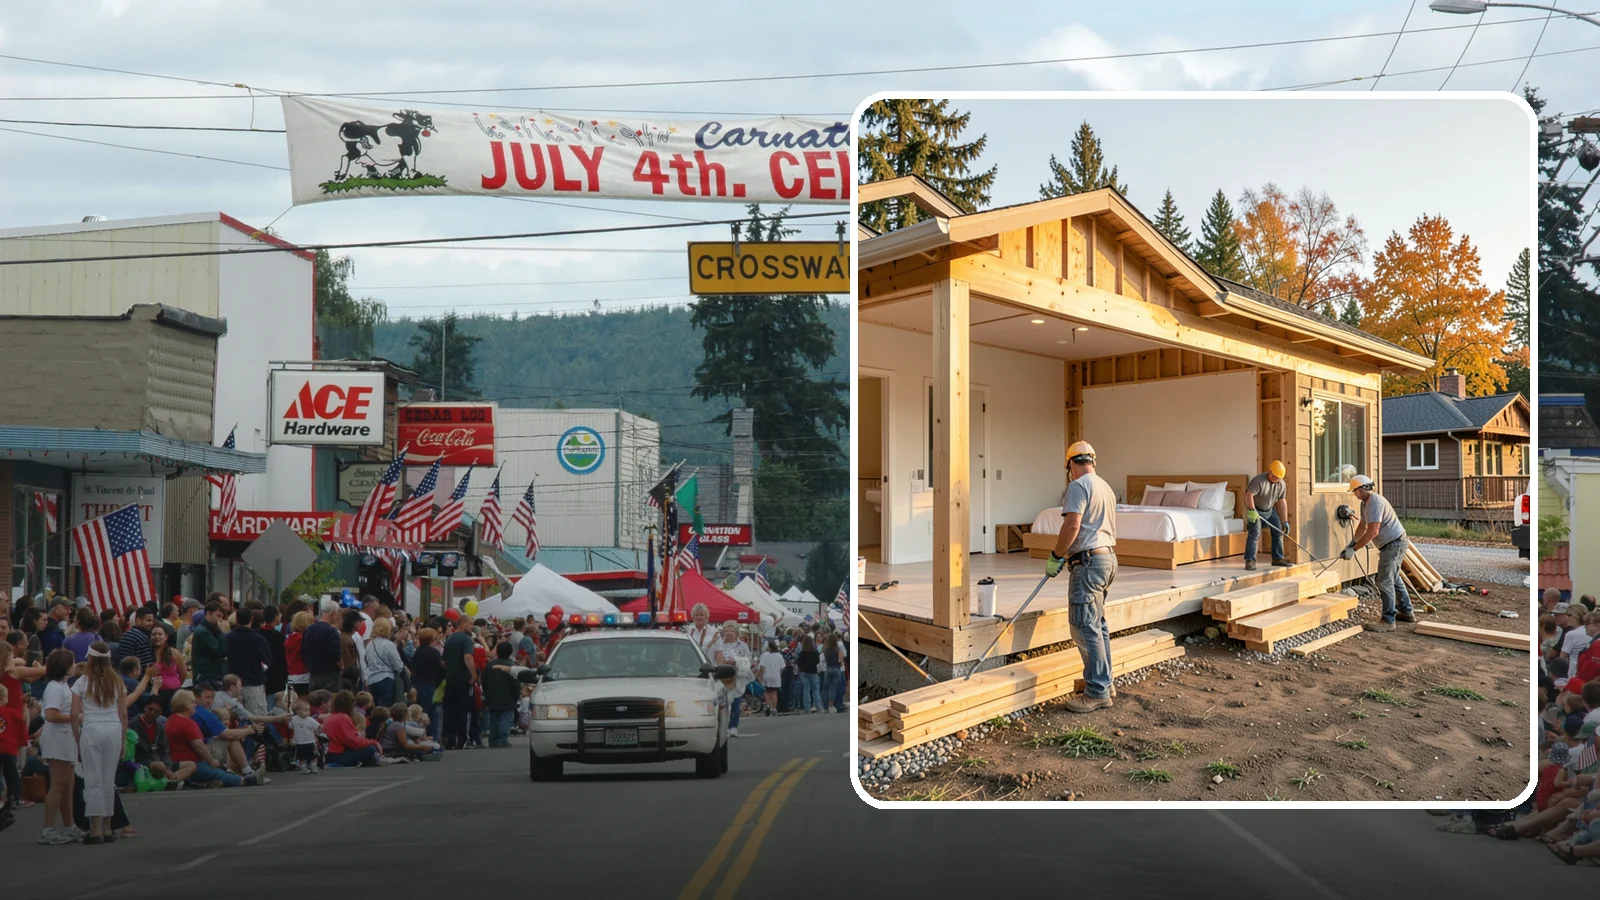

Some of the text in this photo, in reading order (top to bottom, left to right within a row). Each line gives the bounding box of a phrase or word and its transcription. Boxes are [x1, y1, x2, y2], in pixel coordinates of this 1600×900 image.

[481, 141, 605, 193] JULY
[631, 150, 746, 197] 4th.
[697, 254, 850, 280] CROSSWA
[282, 380, 373, 419] ACE
[405, 409, 485, 422] CEDAR LOG
[283, 421, 371, 436] Hardware
[353, 467, 387, 479] Simpl
[95, 485, 125, 495] Vincent
[126, 486, 136, 495] de
[137, 486, 155, 495] Paul
[688, 526, 742, 535] CRNATION
[699, 535, 730, 543] GLASS
